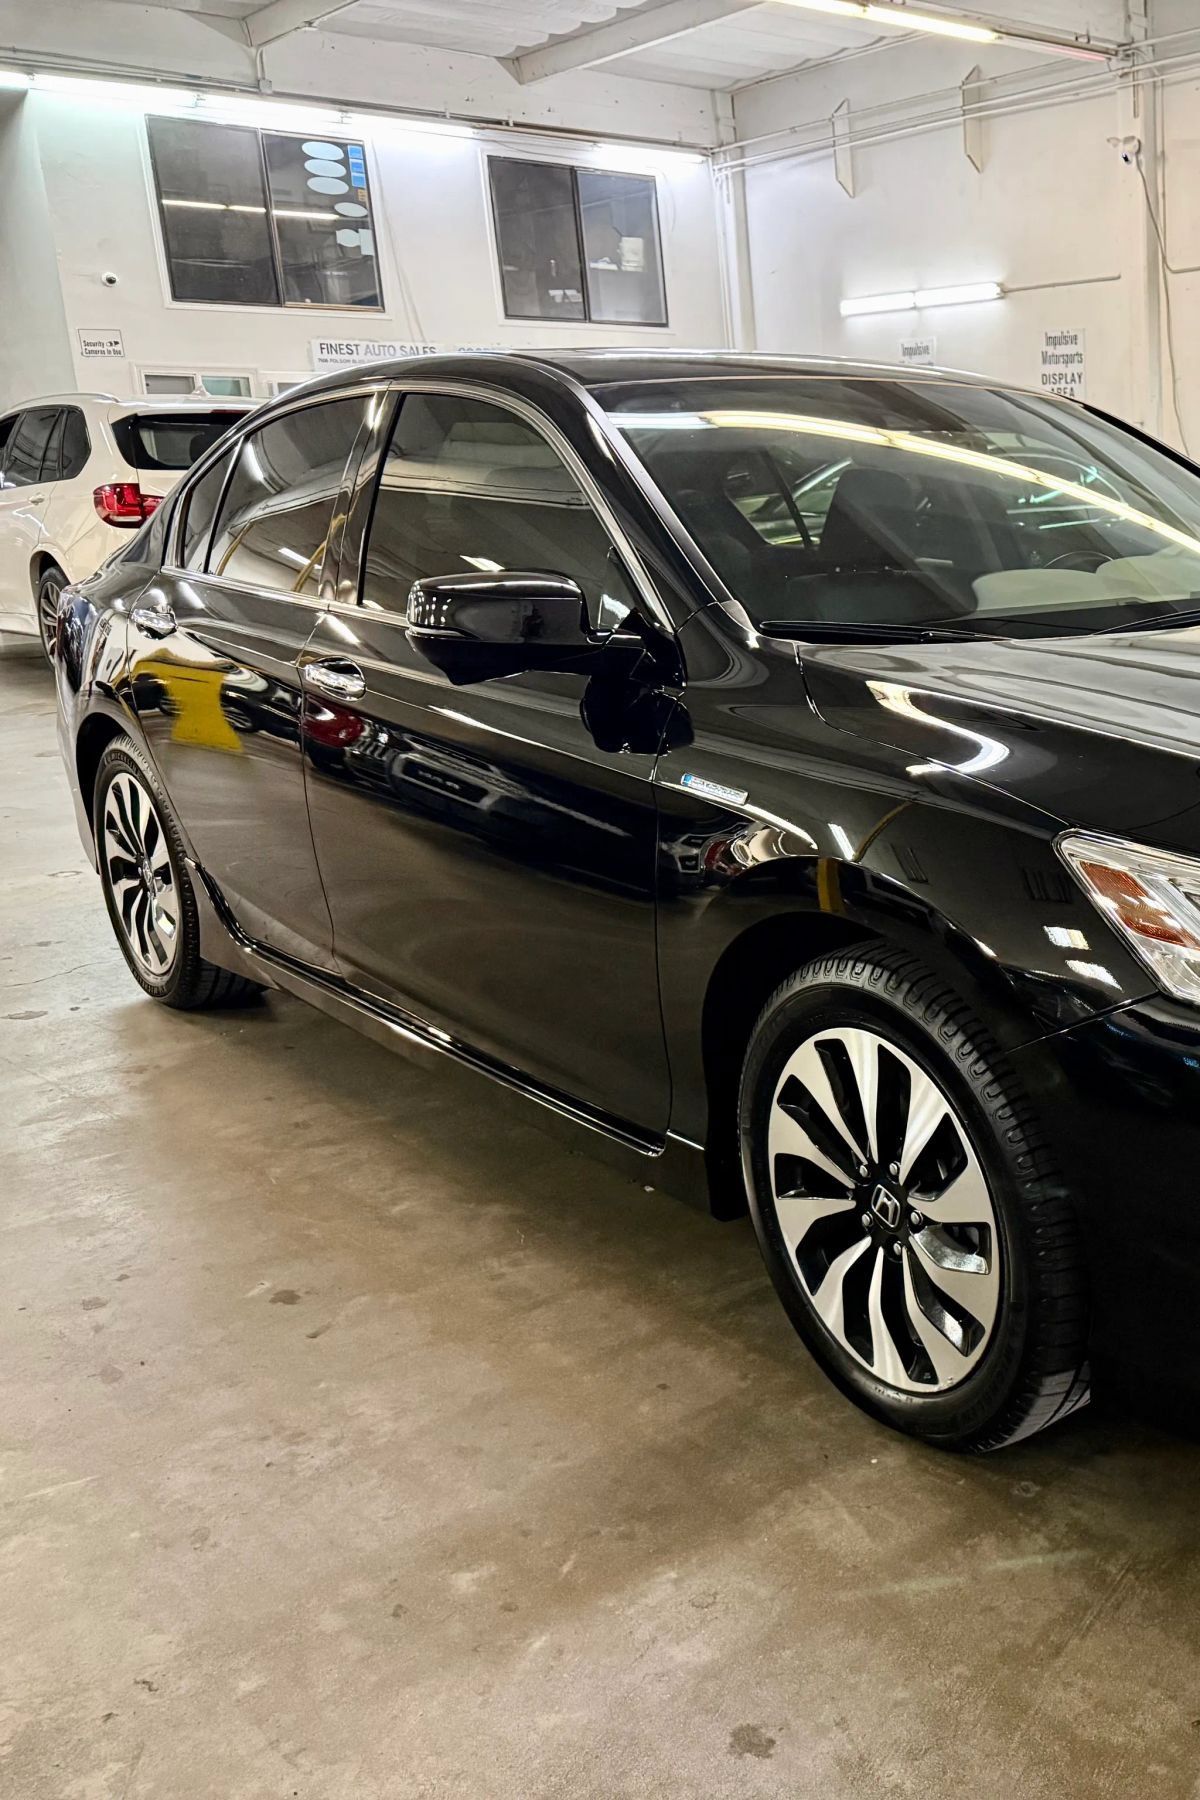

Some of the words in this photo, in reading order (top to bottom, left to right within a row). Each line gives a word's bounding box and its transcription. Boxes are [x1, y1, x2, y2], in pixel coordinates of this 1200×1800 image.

[82, 340, 105, 348] Security
[1045, 330, 1078, 350] Impulsive
[319, 342, 360, 356] FINEST
[364, 344, 396, 357] AUTO
[1041, 372, 1083, 385] DISPLAY
